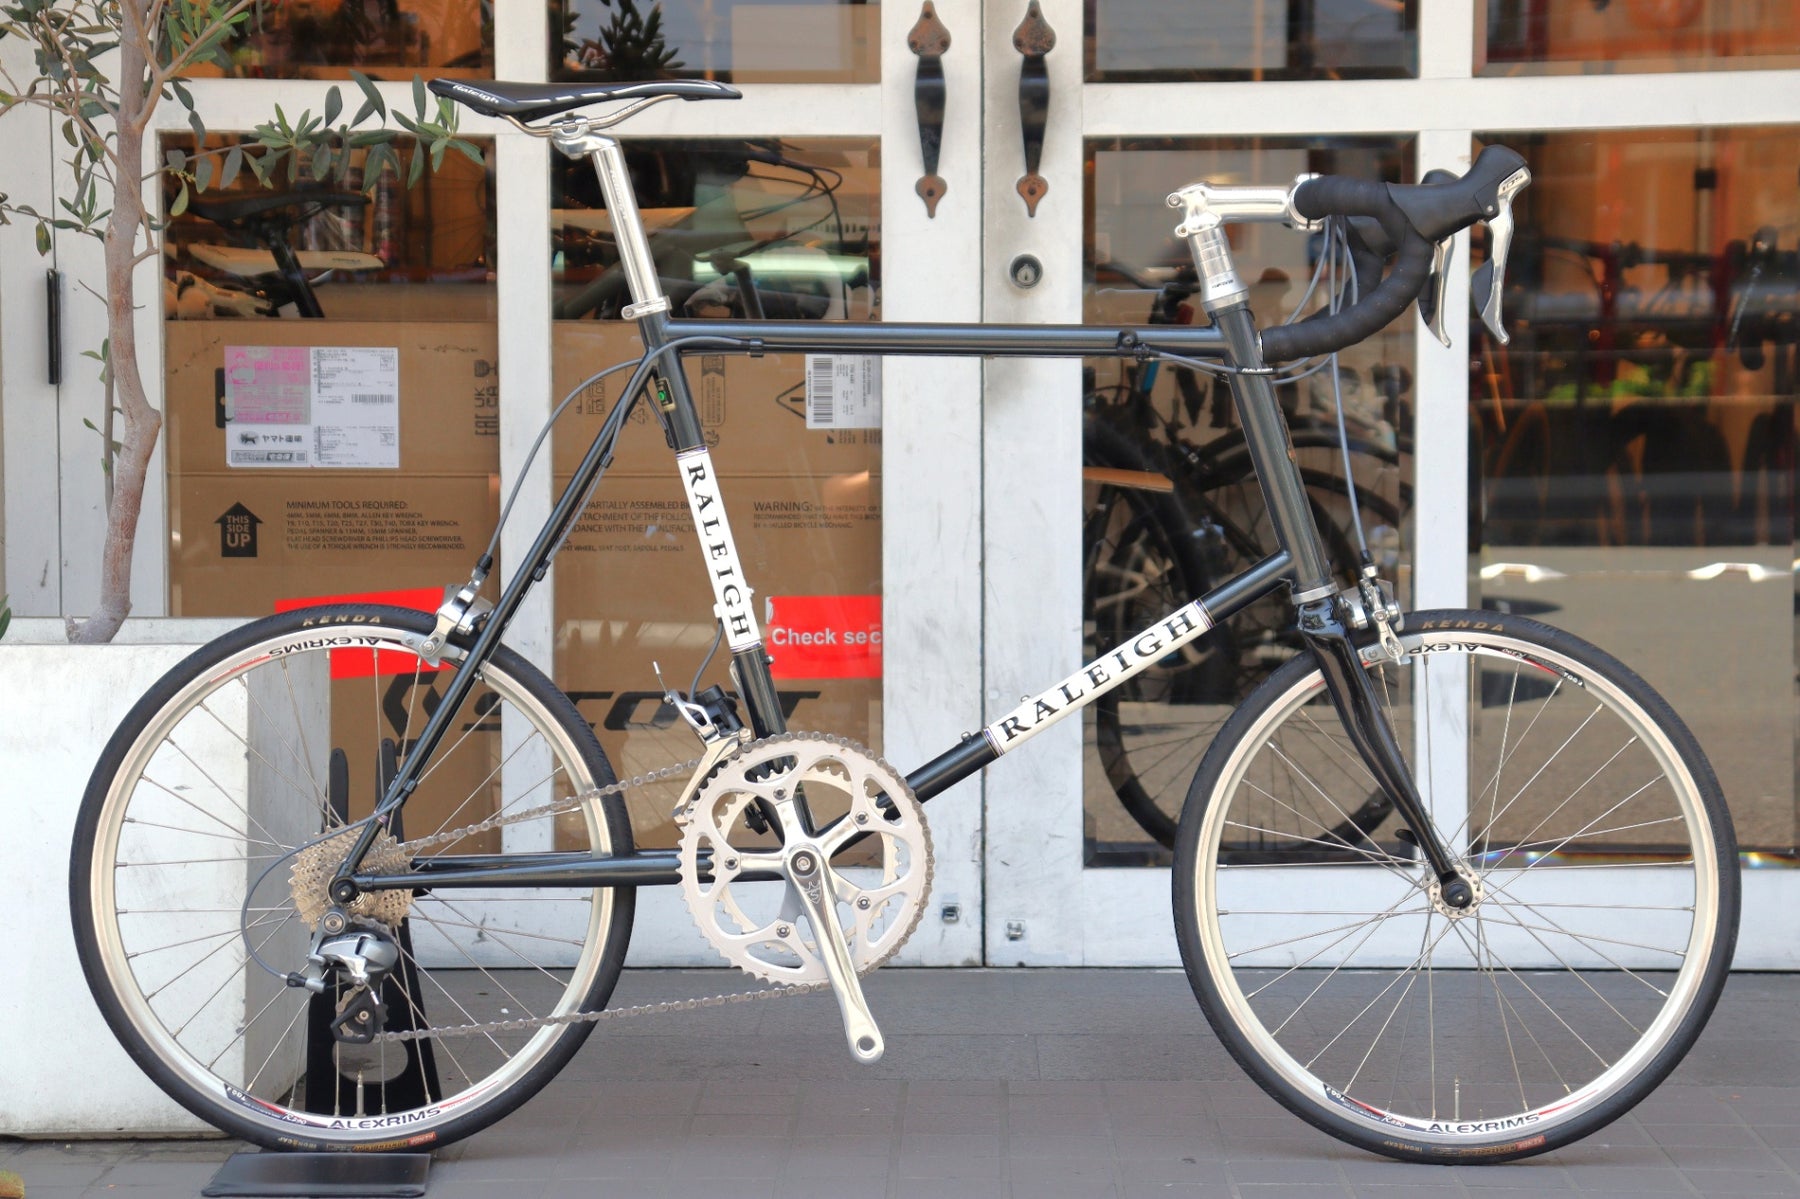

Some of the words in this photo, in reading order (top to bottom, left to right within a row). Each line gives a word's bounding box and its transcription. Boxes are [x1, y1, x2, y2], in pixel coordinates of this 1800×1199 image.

[286, 501, 330, 510] MINIMUM
[332, 501, 360, 510] TOOLS
[362, 501, 408, 510] REQUIRED:
[630, 501, 678, 510] ASSEMBLED
[754, 501, 813, 511] WARNING:
[226, 515, 249, 523] THIS
[226, 524, 249, 533] SIDE
[226, 533, 251, 547] UP
[688, 461, 752, 639] RALEIGH
[303, 614, 381, 627] KENDA
[1422, 620, 1505, 632] KENDA
[771, 627, 837, 645] Check
[269, 637, 382, 656] ALEXRIMS
[997, 610, 1198, 743] RALEIGH
[327, 1106, 442, 1130] ALEXRIMS
[1427, 1113, 1540, 1134] ALEXRIMS
